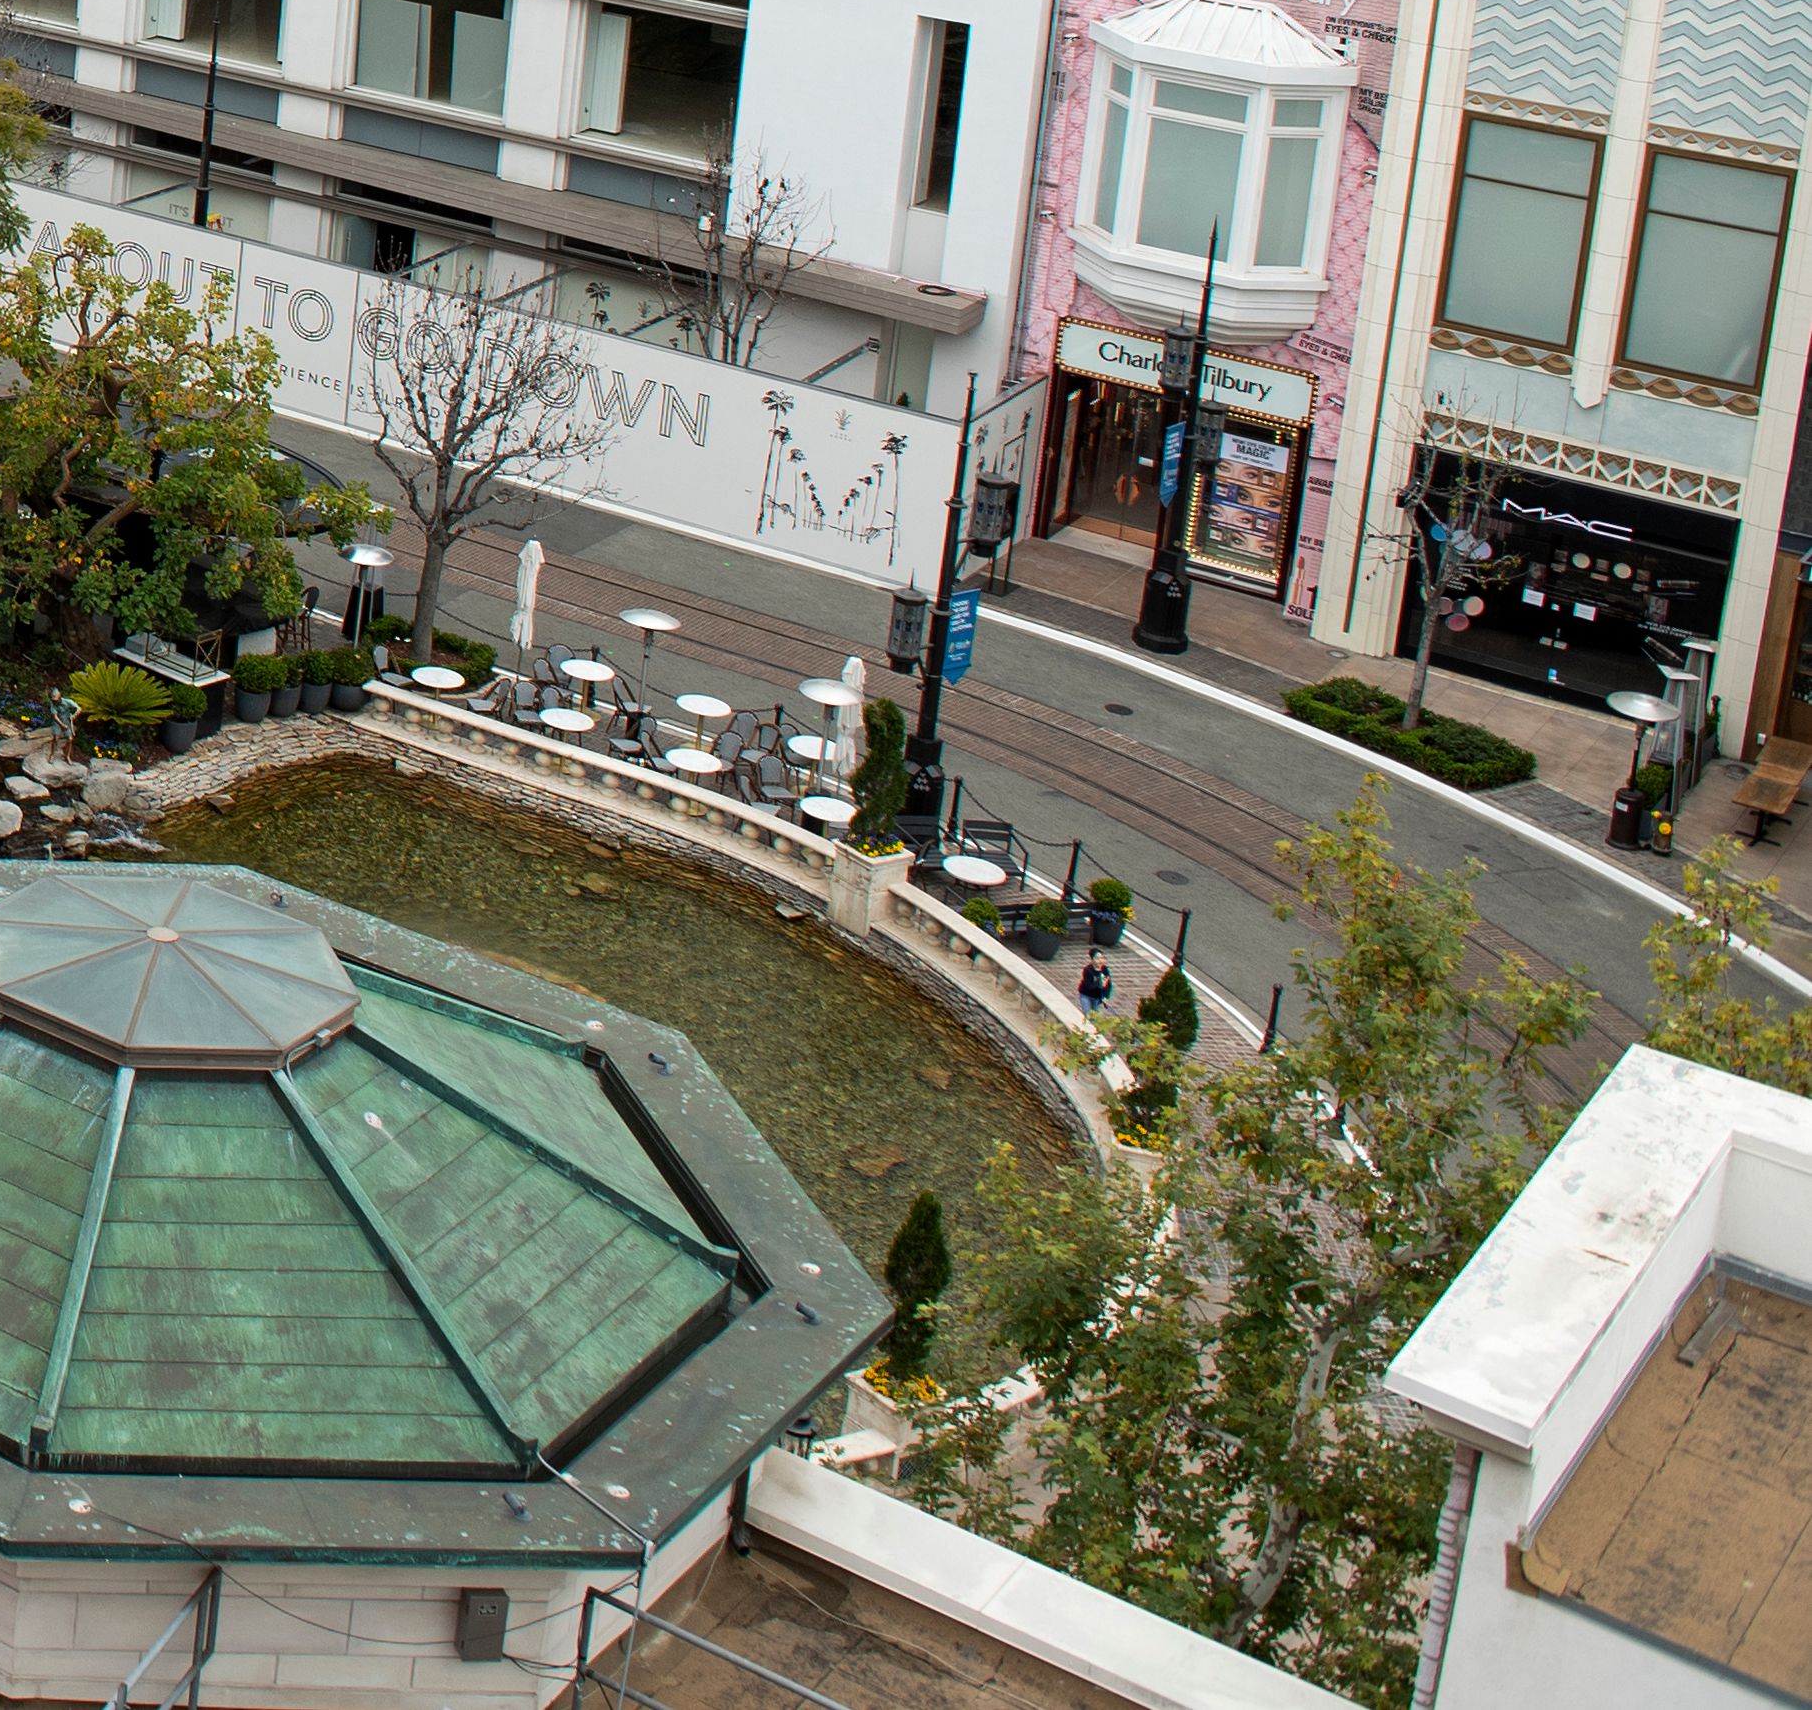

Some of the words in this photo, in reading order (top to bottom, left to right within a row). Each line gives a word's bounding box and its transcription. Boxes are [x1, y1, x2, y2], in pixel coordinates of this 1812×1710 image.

[1324, 23, 1348, 36] EYES
[1351, 28, 1359, 37] &
[254, 276, 334, 342] TO
[356, 308, 454, 374] GO
[480, 336, 711, 448] DOWN
[1202, 364, 1272, 402] Tilbury
[1237, 443, 1271, 461] MAGIC
